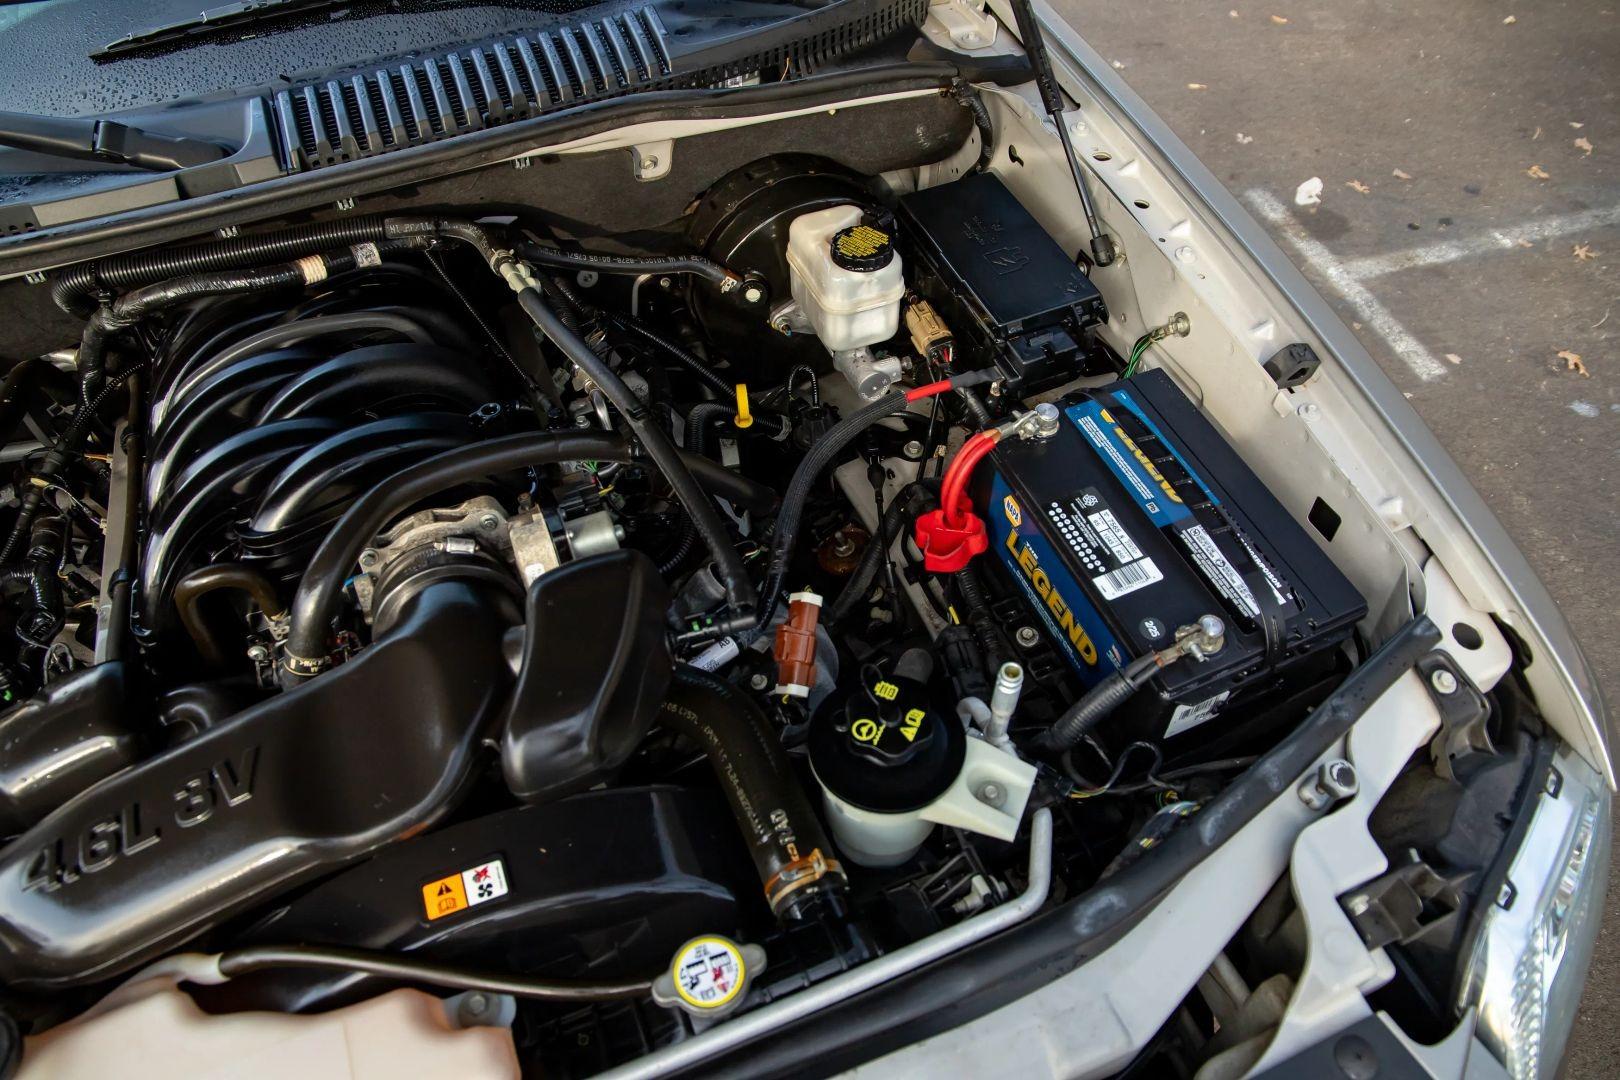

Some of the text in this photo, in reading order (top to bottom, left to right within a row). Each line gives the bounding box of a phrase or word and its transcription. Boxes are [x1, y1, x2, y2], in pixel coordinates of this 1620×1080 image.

[1005, 499, 1020, 521] NAPA
[1147, 503, 1157, 513] Pb
[1109, 519, 1121, 533] 7565
[1005, 528, 1098, 667] LEGEND
[1144, 620, 1160, 637] 2/25
[21, 744, 261, 893] 4.6L 3V
